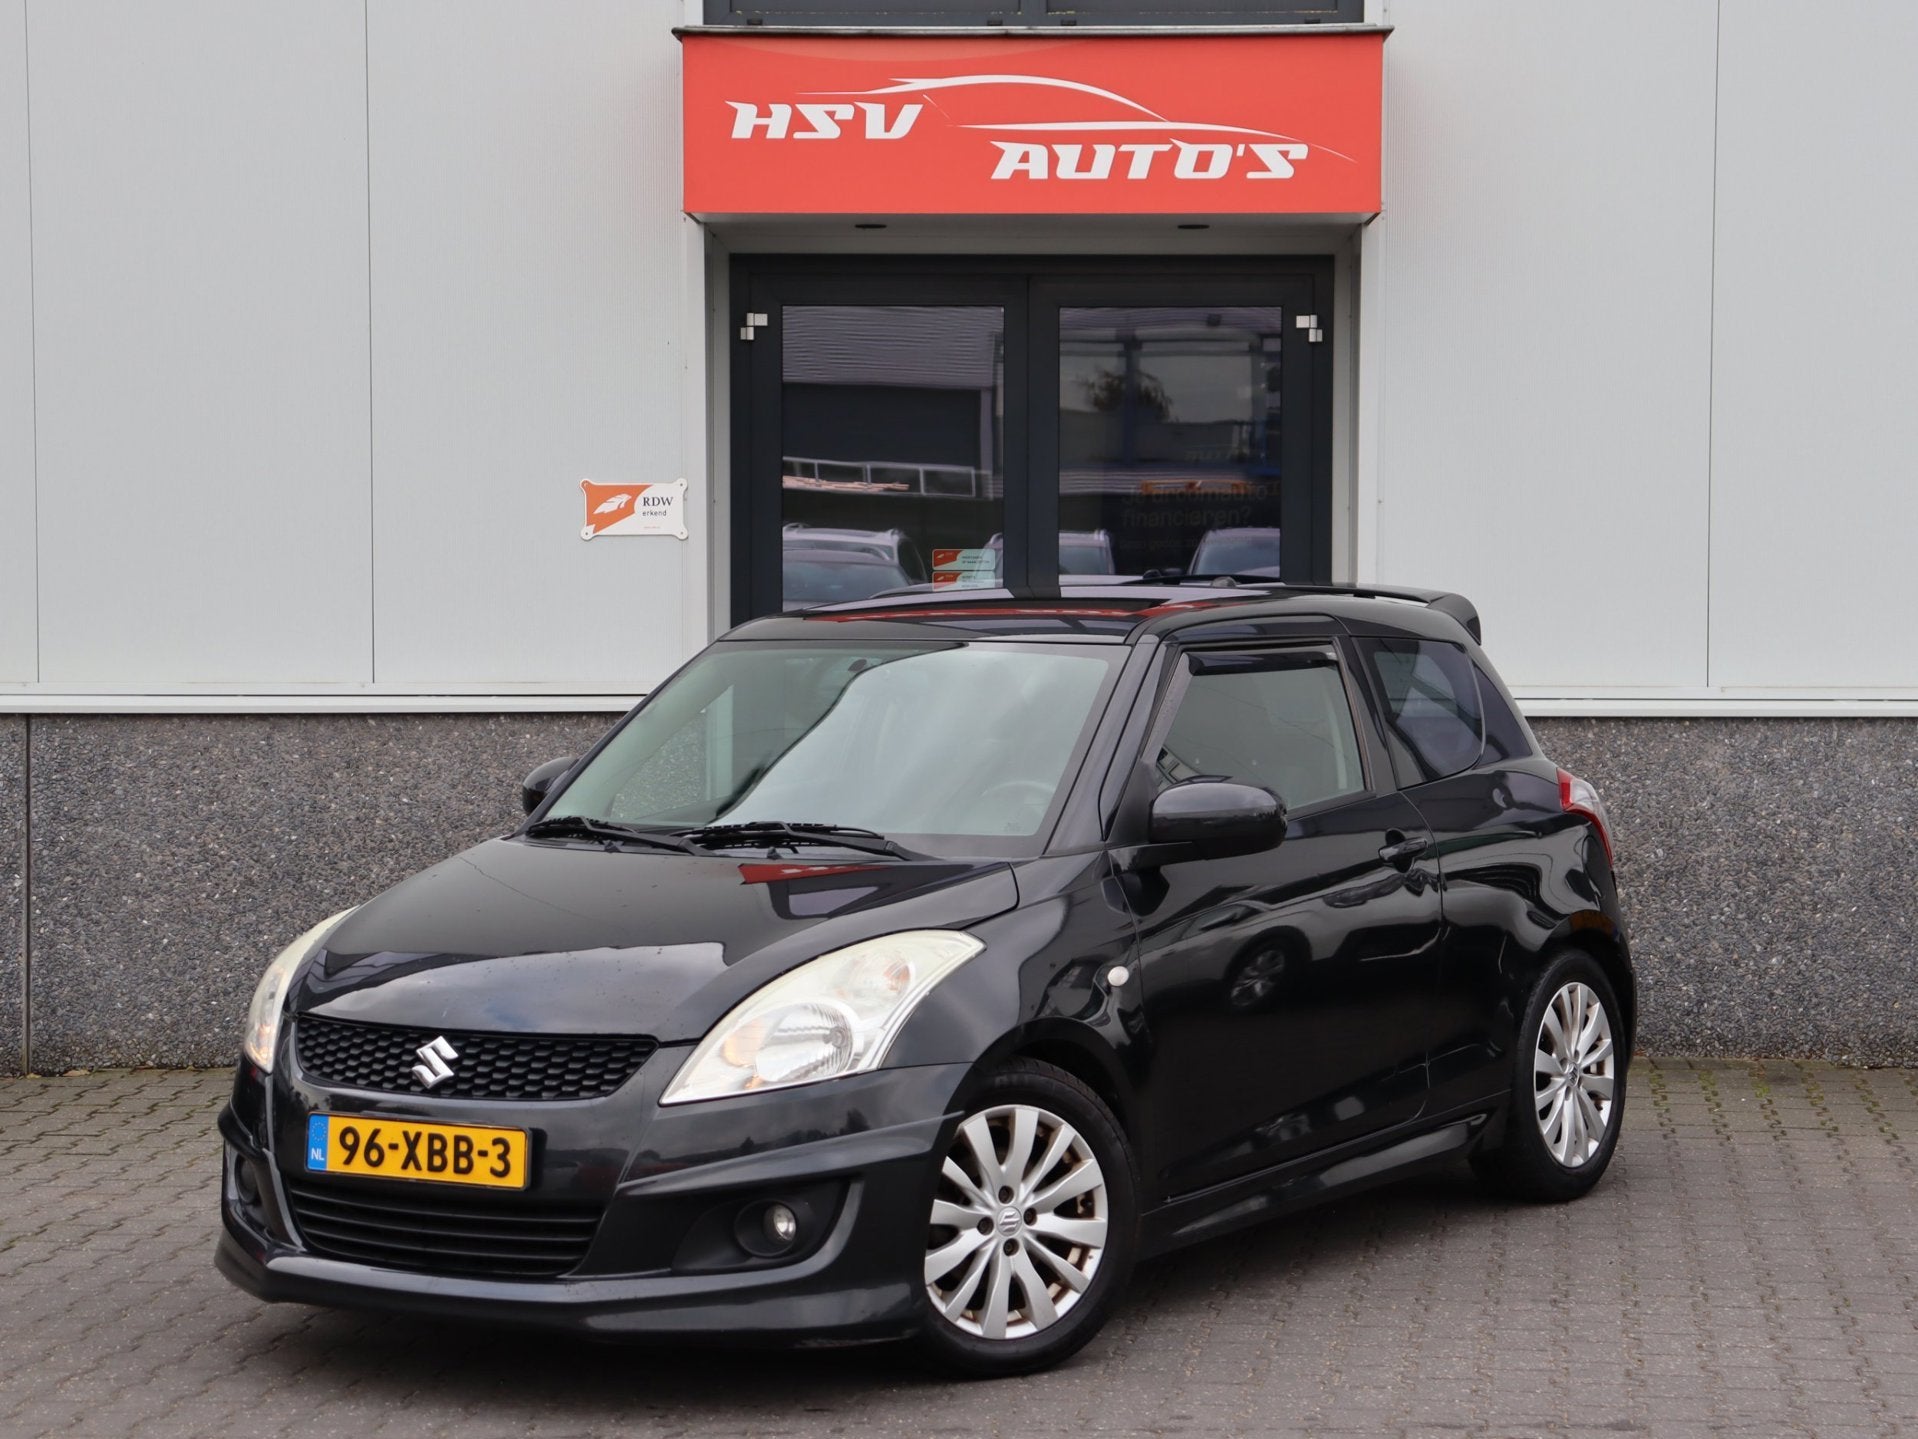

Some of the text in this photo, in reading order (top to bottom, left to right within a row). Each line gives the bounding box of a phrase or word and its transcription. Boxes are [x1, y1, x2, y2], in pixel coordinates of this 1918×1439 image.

[725, 100, 923, 141] HSV
[989, 137, 1309, 180] AUTO'S
[642, 496, 674, 507] RDW
[642, 509, 667, 517] erkend
[1121, 506, 1252, 528] financieren?
[311, 1147, 325, 1161] NL
[338, 1125, 512, 1179] 96-XBB-3
